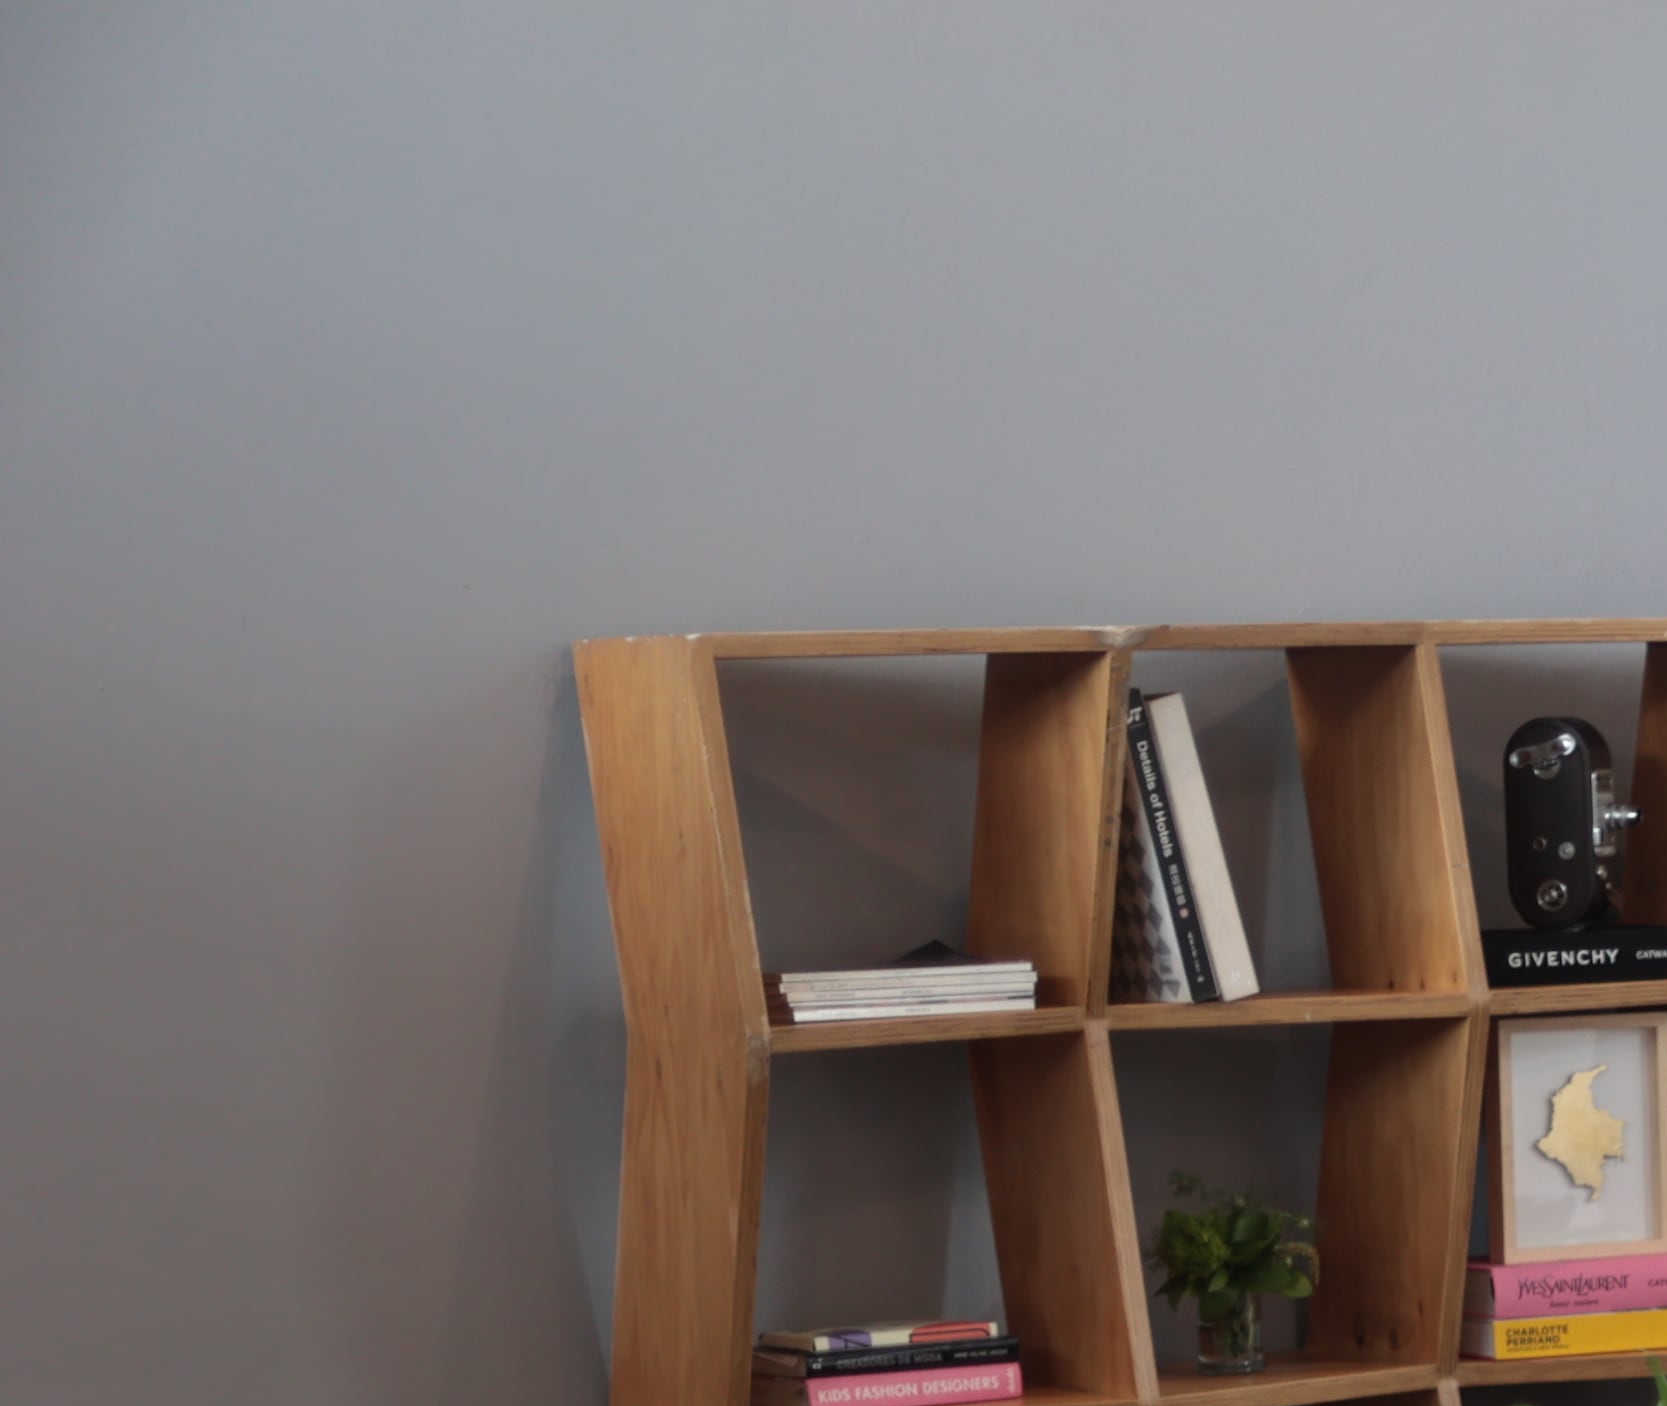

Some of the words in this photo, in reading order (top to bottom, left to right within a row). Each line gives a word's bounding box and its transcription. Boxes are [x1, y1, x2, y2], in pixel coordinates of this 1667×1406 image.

[1136, 740, 1158, 790] Details
[1149, 792, 1164, 809] of
[1153, 810, 1174, 859] Hotels
[1508, 948, 1619, 968] GIVENCHY
[1505, 1324, 1569, 1337] CHARLOTTE
[1506, 1334, 1561, 1347] PERRIAND
[836, 1354, 896, 1371] CREADORES
[898, 1354, 911, 1365] DE
[914, 1353, 943, 1364] MODA
[818, 1388, 851, 1404] KIDS
[854, 1382, 918, 1401] FASHION
[922, 1375, 999, 1395] DESIGNERS
